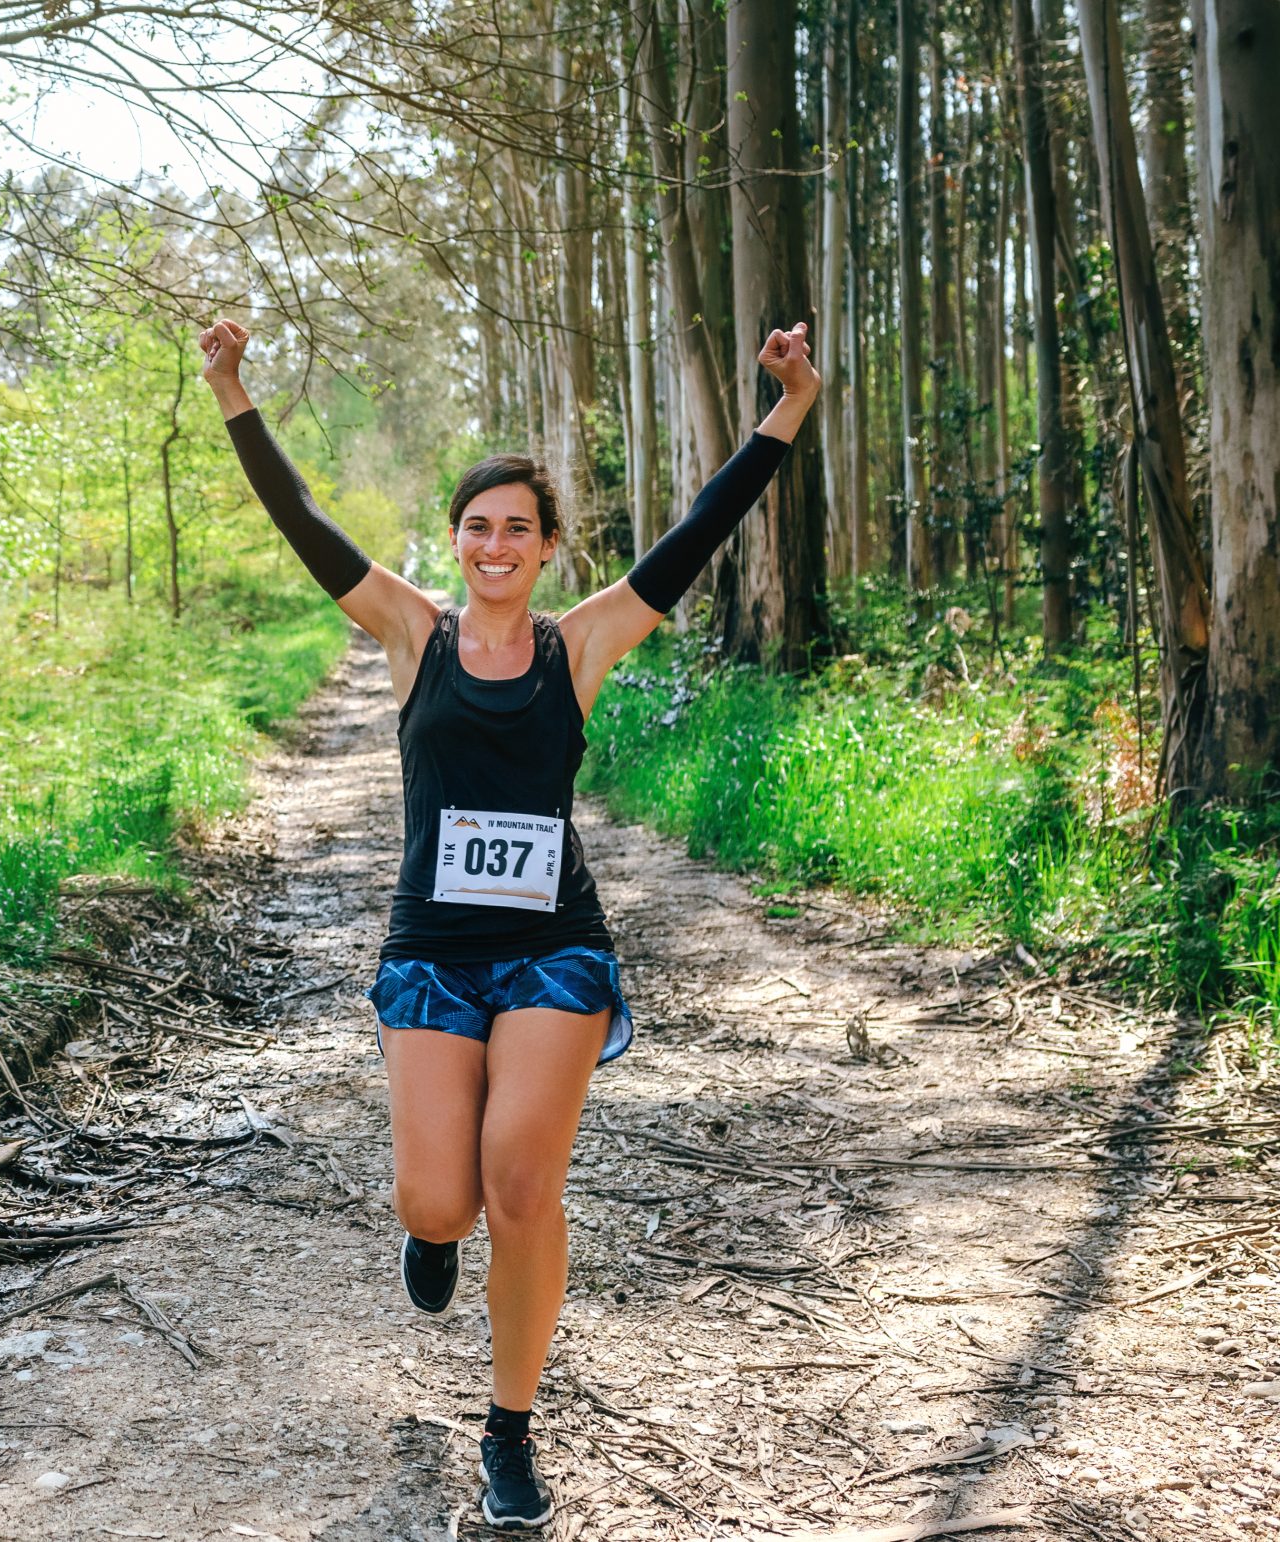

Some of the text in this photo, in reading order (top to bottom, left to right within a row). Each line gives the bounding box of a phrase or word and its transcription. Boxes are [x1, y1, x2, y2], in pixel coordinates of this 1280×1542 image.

[488, 820, 555, 833] IV MOUNTAIN TRAIL
[464, 837, 534, 878] 037
[547, 849, 556, 858] 28
